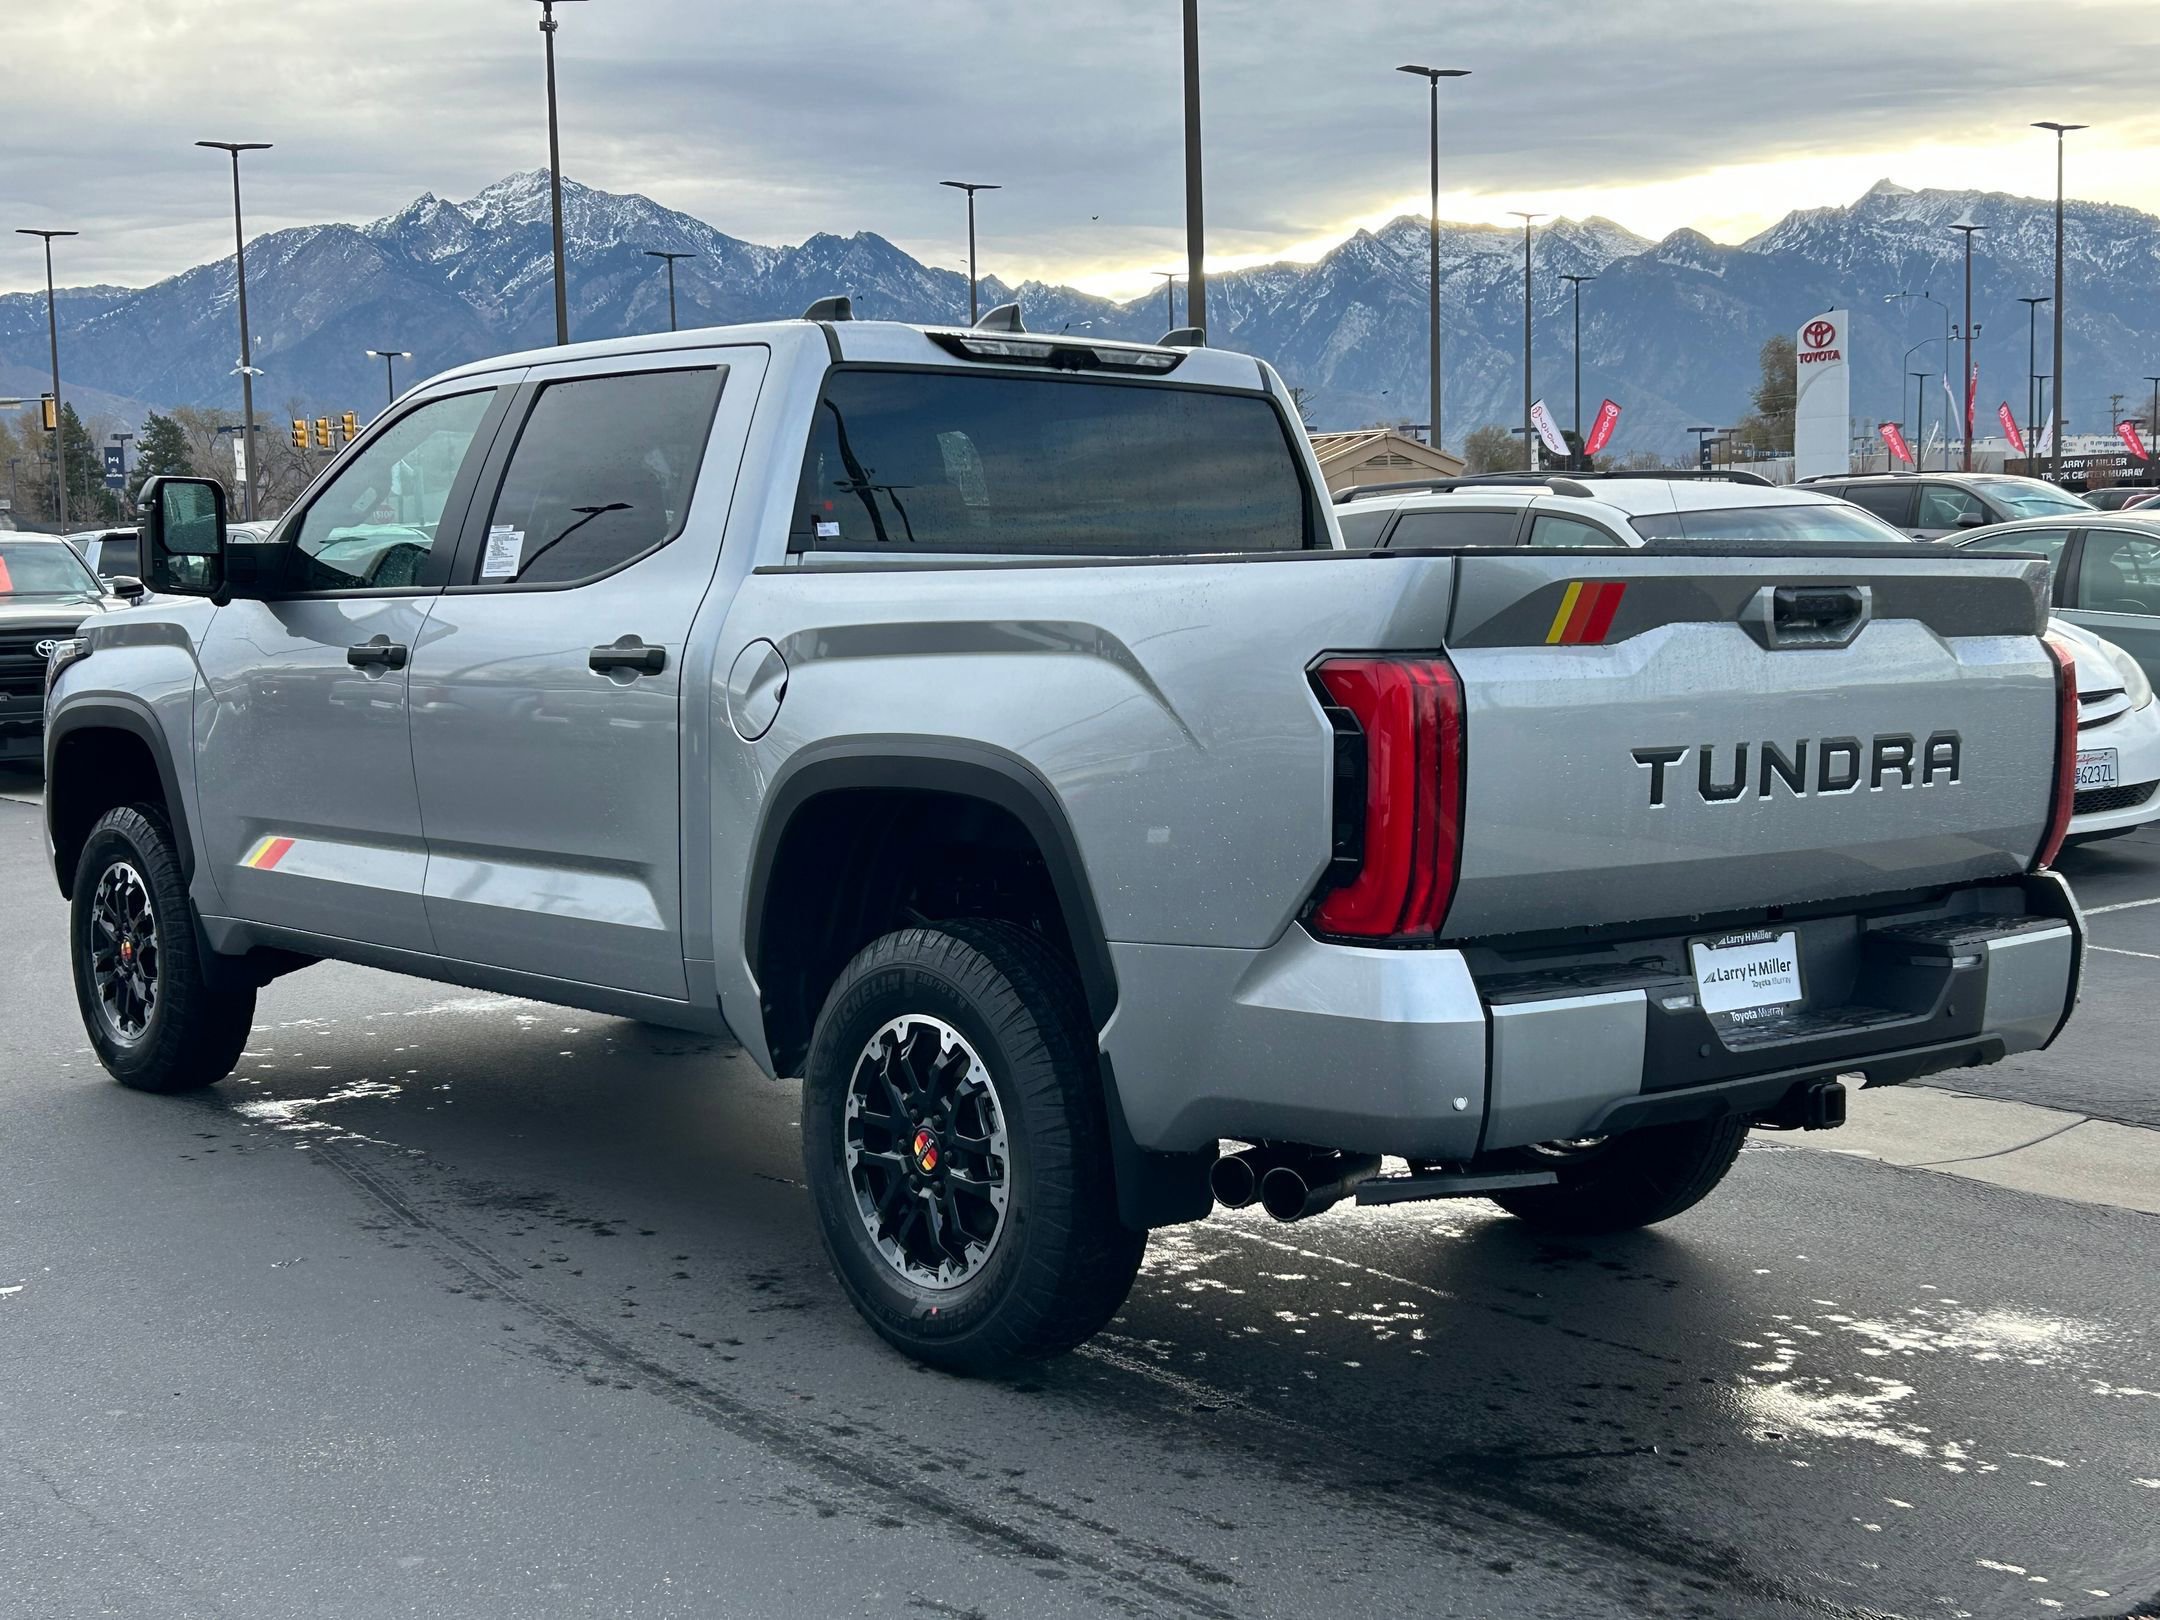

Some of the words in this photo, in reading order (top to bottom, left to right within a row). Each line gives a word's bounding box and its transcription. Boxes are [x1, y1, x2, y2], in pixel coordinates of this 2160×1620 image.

[1798, 349, 1841, 364] TOYOTA
[1539, 417, 1560, 451] TOYOTA
[1593, 416, 1612, 450] TOYOTA
[2108, 468, 2144, 477] MURRAY
[1630, 729, 1962, 810] TUNDRA
[1726, 935, 1744, 944] Larry
[1745, 933, 1751, 941] H
[1752, 930, 1772, 940] Miller
[1717, 967, 1746, 981] Larry
[1748, 963, 1757, 976] H
[1759, 958, 1791, 975] Miller
[1752, 980, 1771, 988] Toyota
[1730, 1010, 1757, 1023] Toyota
[1758, 1007, 1784, 1018] Murray
